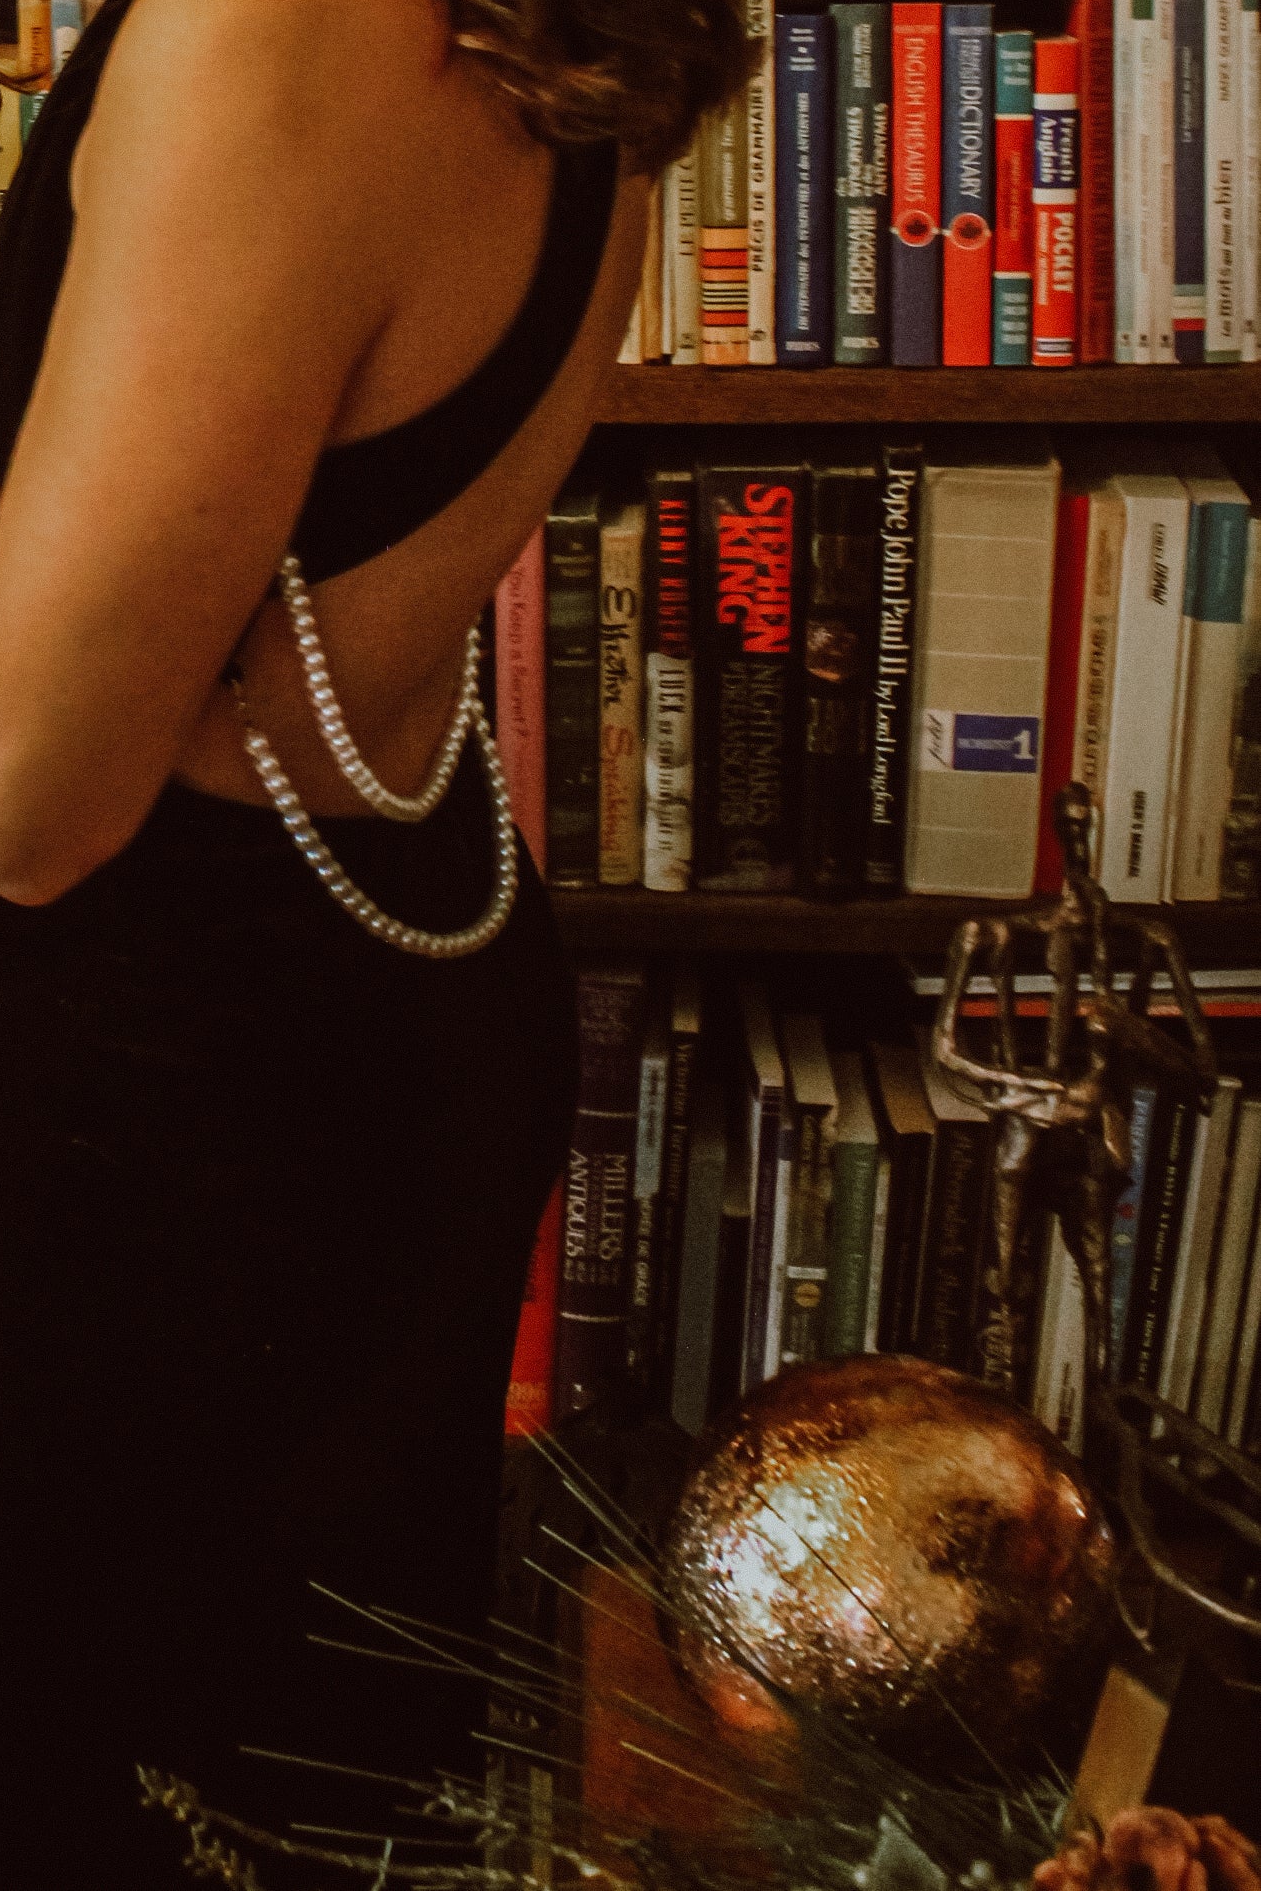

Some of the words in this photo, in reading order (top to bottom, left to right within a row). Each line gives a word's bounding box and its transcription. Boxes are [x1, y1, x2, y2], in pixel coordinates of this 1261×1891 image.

[903, 38, 925, 106] ENGLISH
[751, 85, 765, 183] GRAMMAIRE
[846, 107, 861, 197] SYNONYMES
[873, 103, 888, 196] ANTONYMES
[903, 111, 925, 202] THESAURUS
[959, 86, 982, 198] DICTIONARY
[1036, 118, 1058, 183] Anglais
[1059, 116, 1076, 182] French
[752, 191, 763, 211] DE
[1214, 160, 1233, 205] bien
[1053, 211, 1075, 293] POCKET
[658, 500, 689, 564] KENNY
[879, 468, 917, 530] Pope
[716, 512, 757, 625] KING
[742, 483, 794, 653] STEPHEN
[879, 531, 915, 591] John
[506, 604, 526, 644] Keep
[879, 597, 912, 650] Paul
[658, 669, 685, 714] LUCK
[873, 680, 896, 701] by
[876, 653, 909, 675] II
[509, 664, 527, 737] Secret?
[874, 703, 899, 743] Lord
[719, 670, 746, 826] DREAMSCAPES
[747, 661, 785, 826] NIGHTMARES
[1013, 730, 1034, 759] 1
[869, 746, 896, 824] Longford
[1128, 833, 1145, 879] MANUAL
[566, 1148, 588, 1258] ANTIQUES
